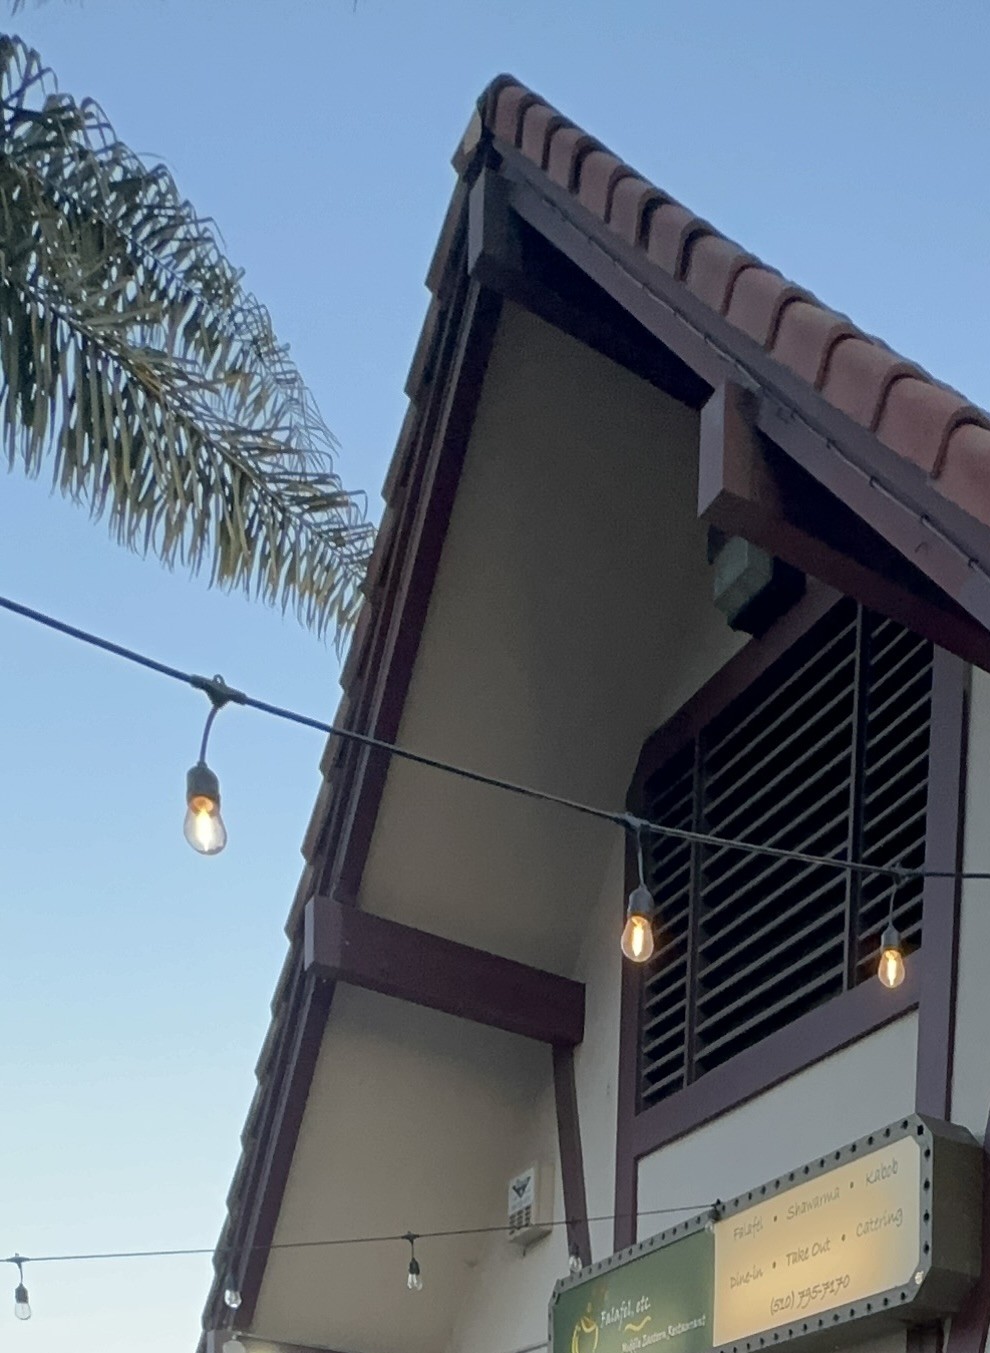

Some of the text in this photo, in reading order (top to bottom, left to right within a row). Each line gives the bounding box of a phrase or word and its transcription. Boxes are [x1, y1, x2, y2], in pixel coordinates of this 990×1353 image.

[732, 1157, 899, 1241] Falafel Shawarma Kabob
[730, 1208, 904, 1289] Dine-in Take Out Catering
[769, 1274, 851, 1316] (510) 795-7170
